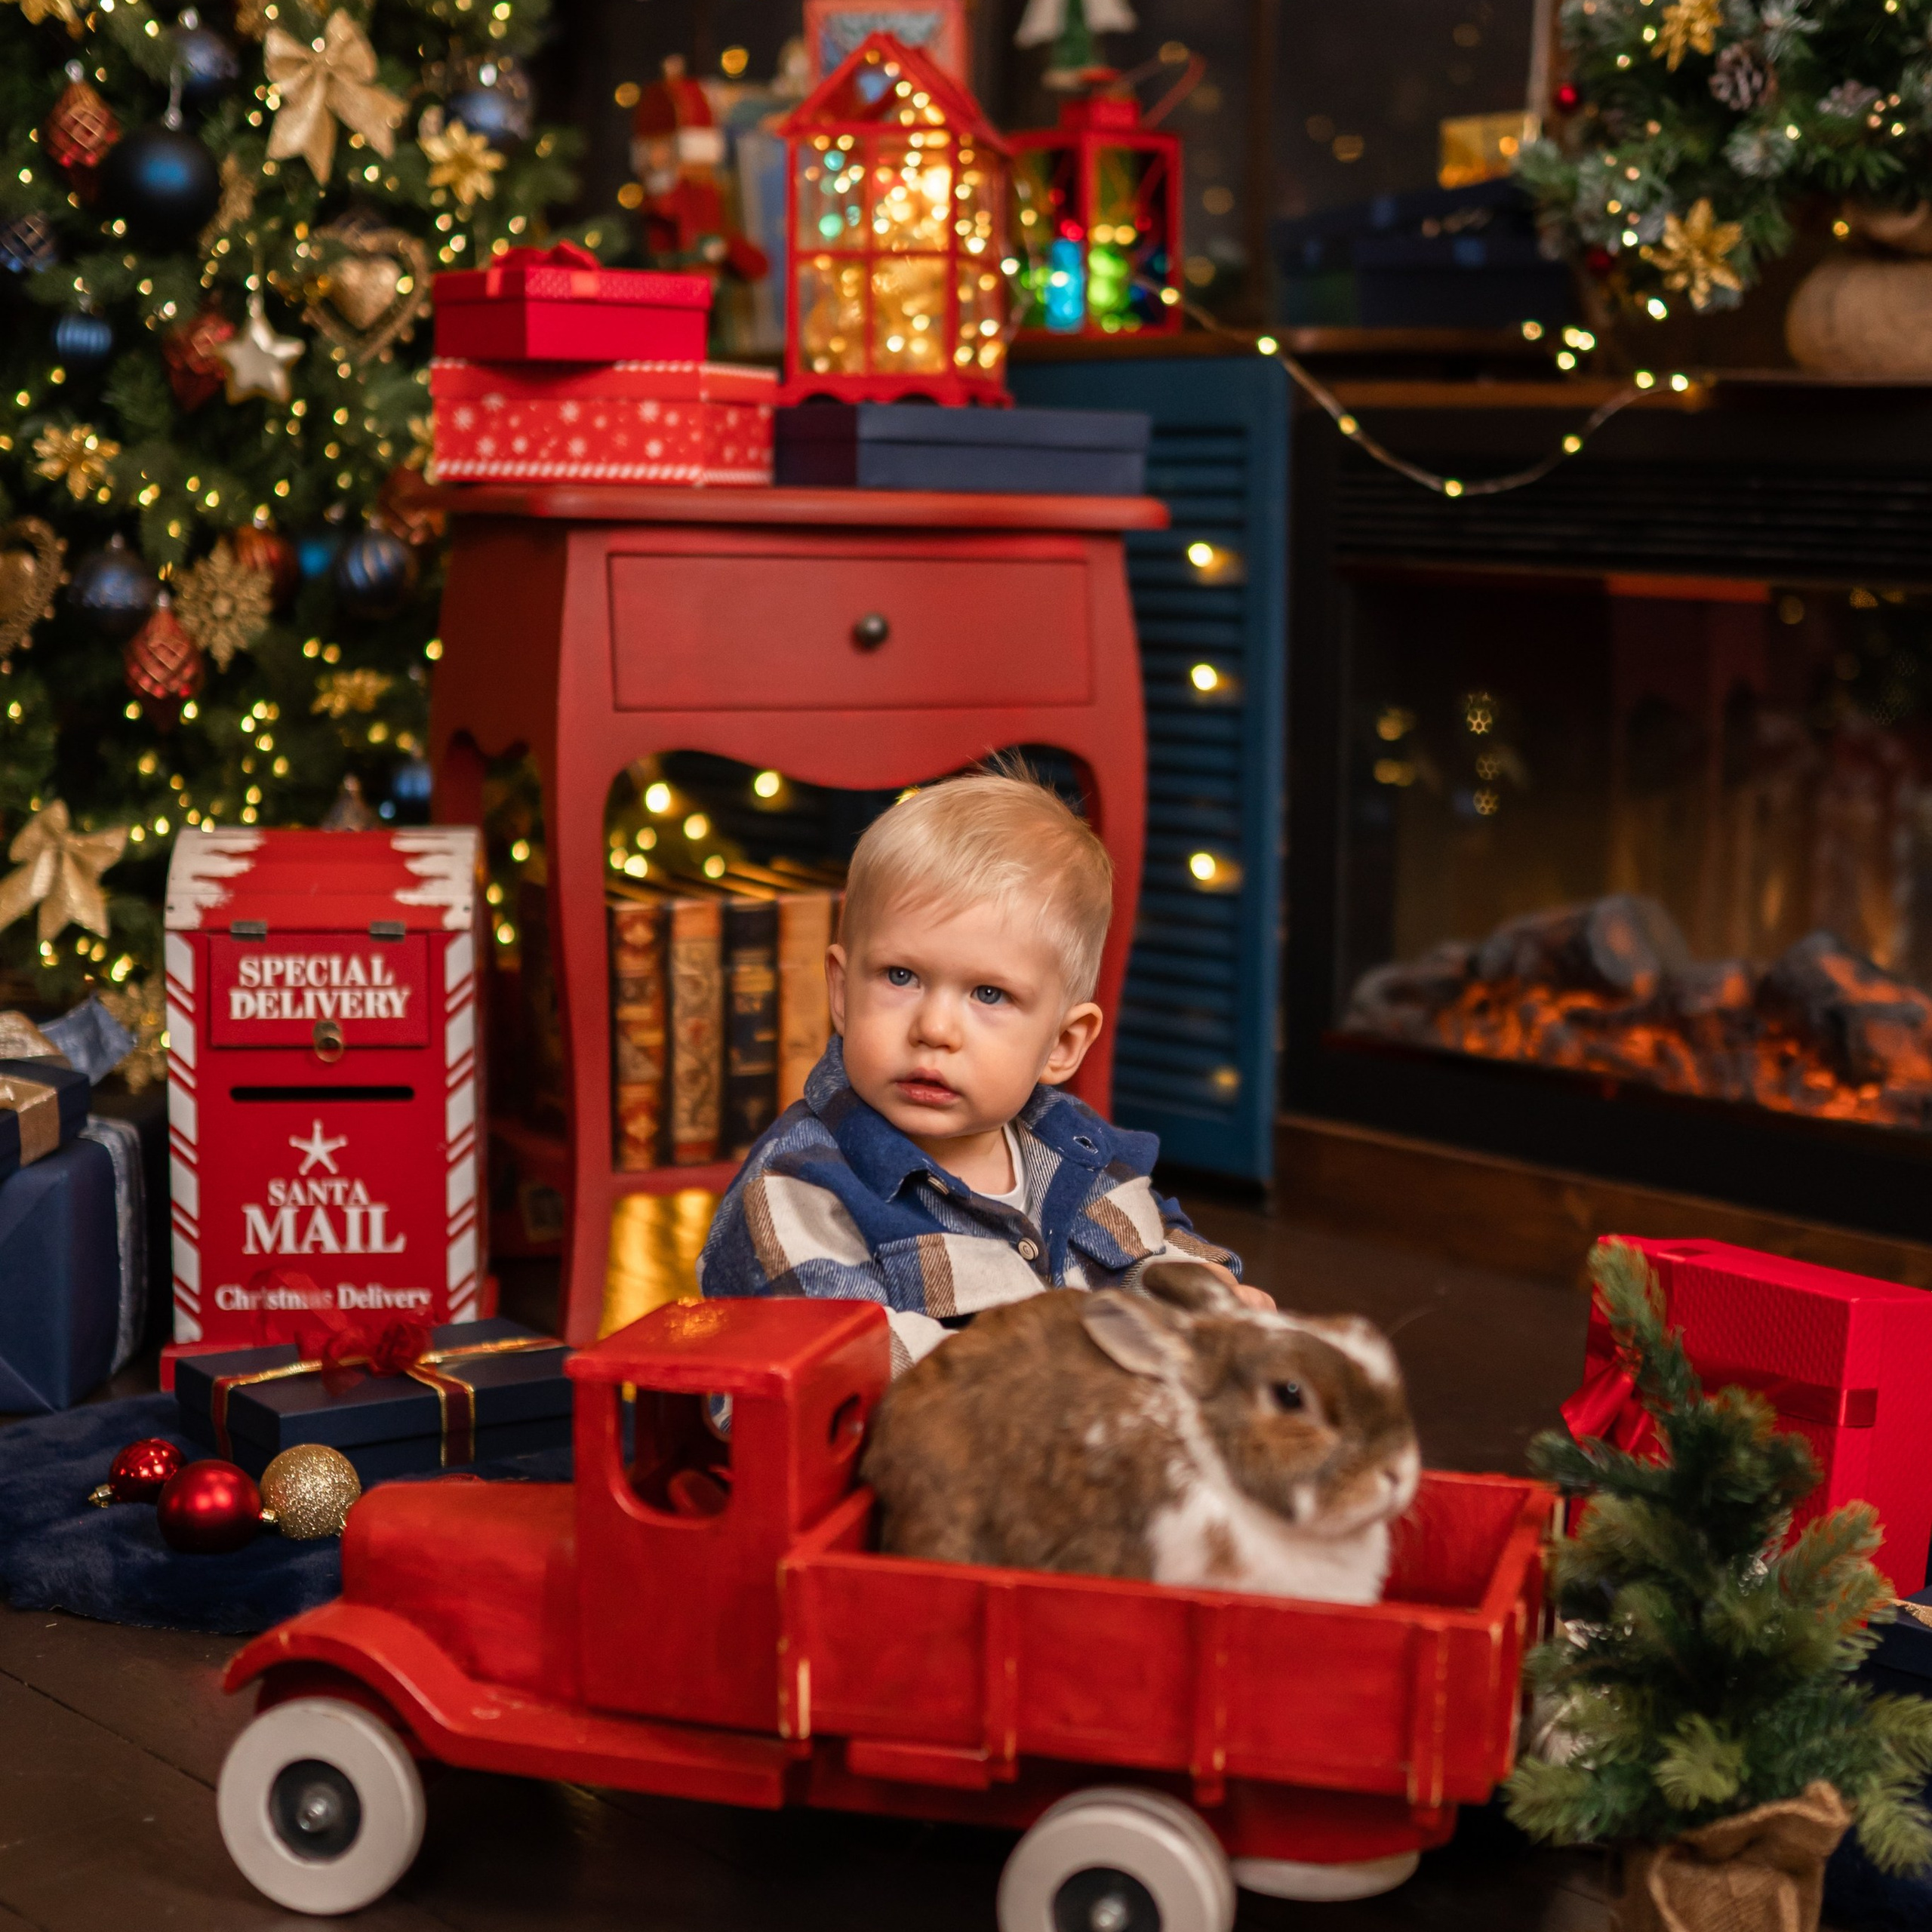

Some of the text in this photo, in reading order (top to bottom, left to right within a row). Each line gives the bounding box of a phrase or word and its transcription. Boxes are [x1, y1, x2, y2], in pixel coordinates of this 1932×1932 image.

[238, 955, 393, 987] SPECIAL
[229, 989, 411, 1020] DELIVERY
[267, 1178, 371, 1206] SANTA
[242, 1204, 407, 1254] MAIL
[337, 1283, 432, 1315] Delivery
